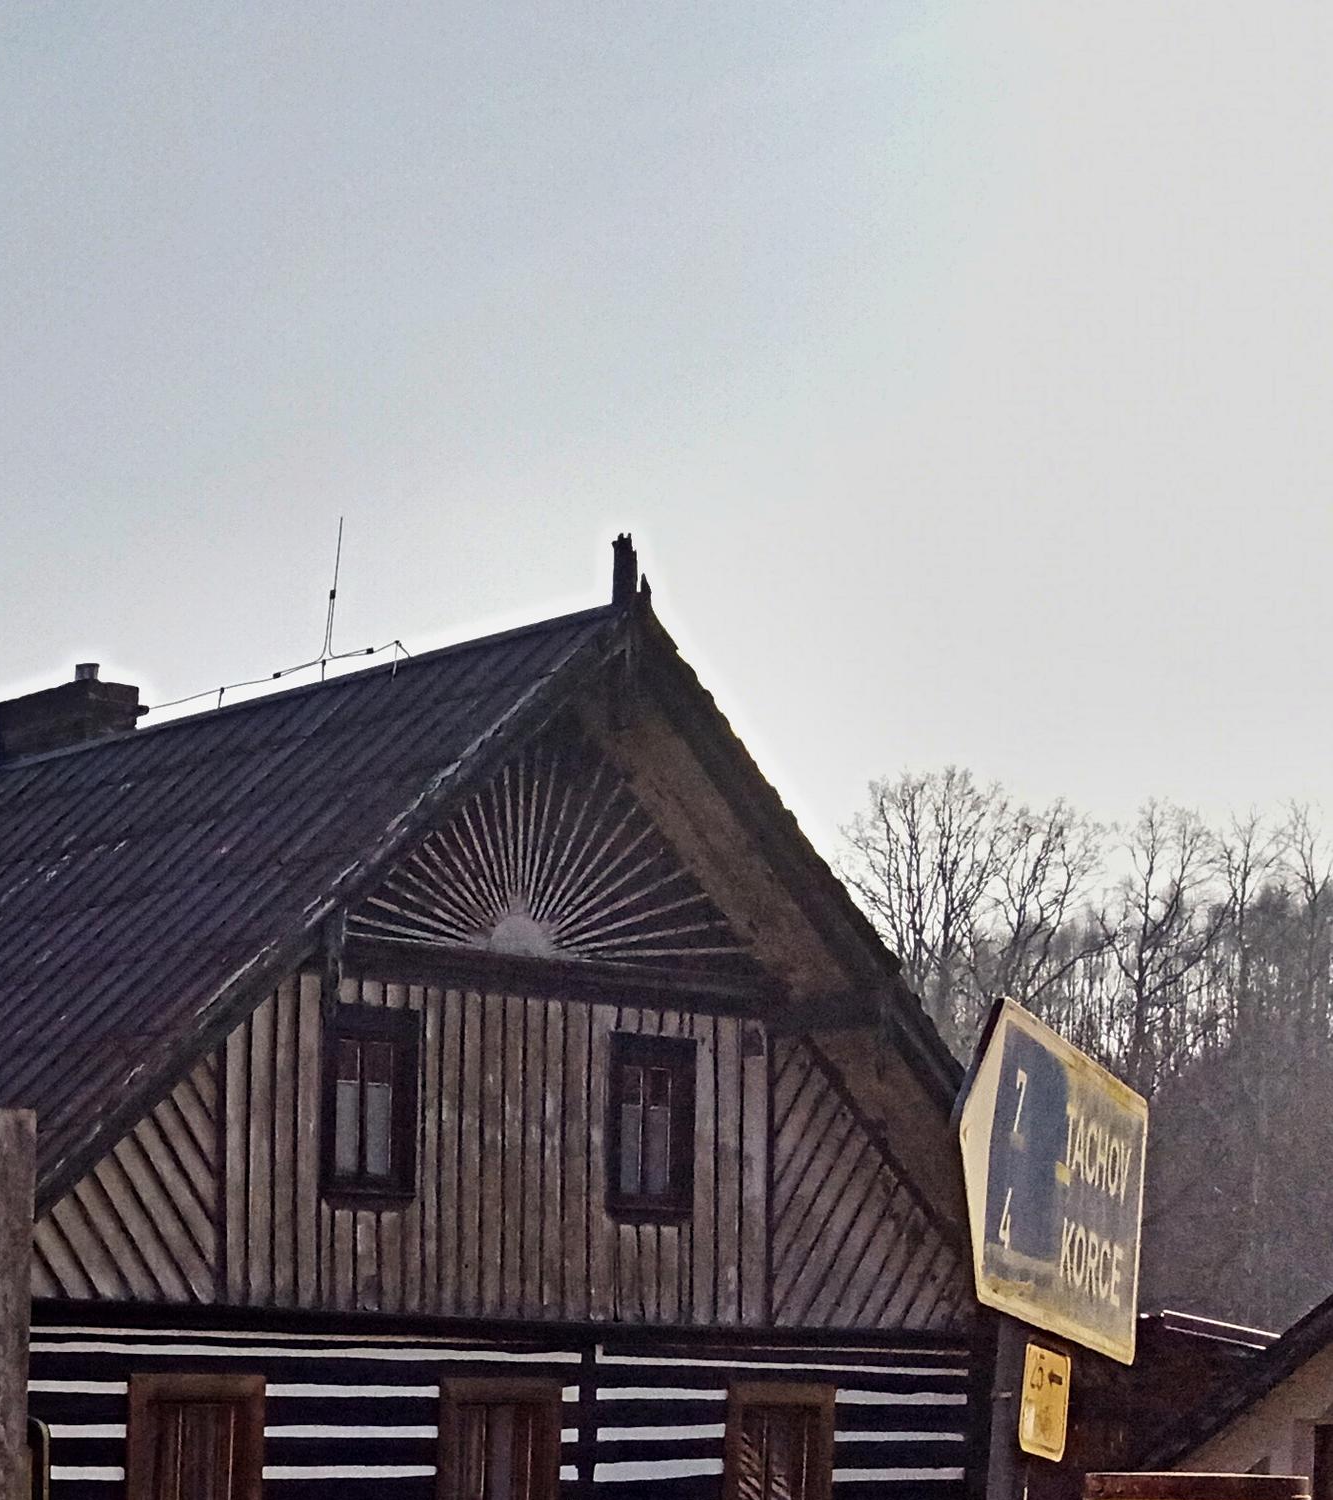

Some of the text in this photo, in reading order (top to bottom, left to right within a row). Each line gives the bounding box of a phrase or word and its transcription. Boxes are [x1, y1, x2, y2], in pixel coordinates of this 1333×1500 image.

[1065, 1102, 1132, 1206] TACHOV
[998, 1187, 1124, 1308] 4 KORCE
